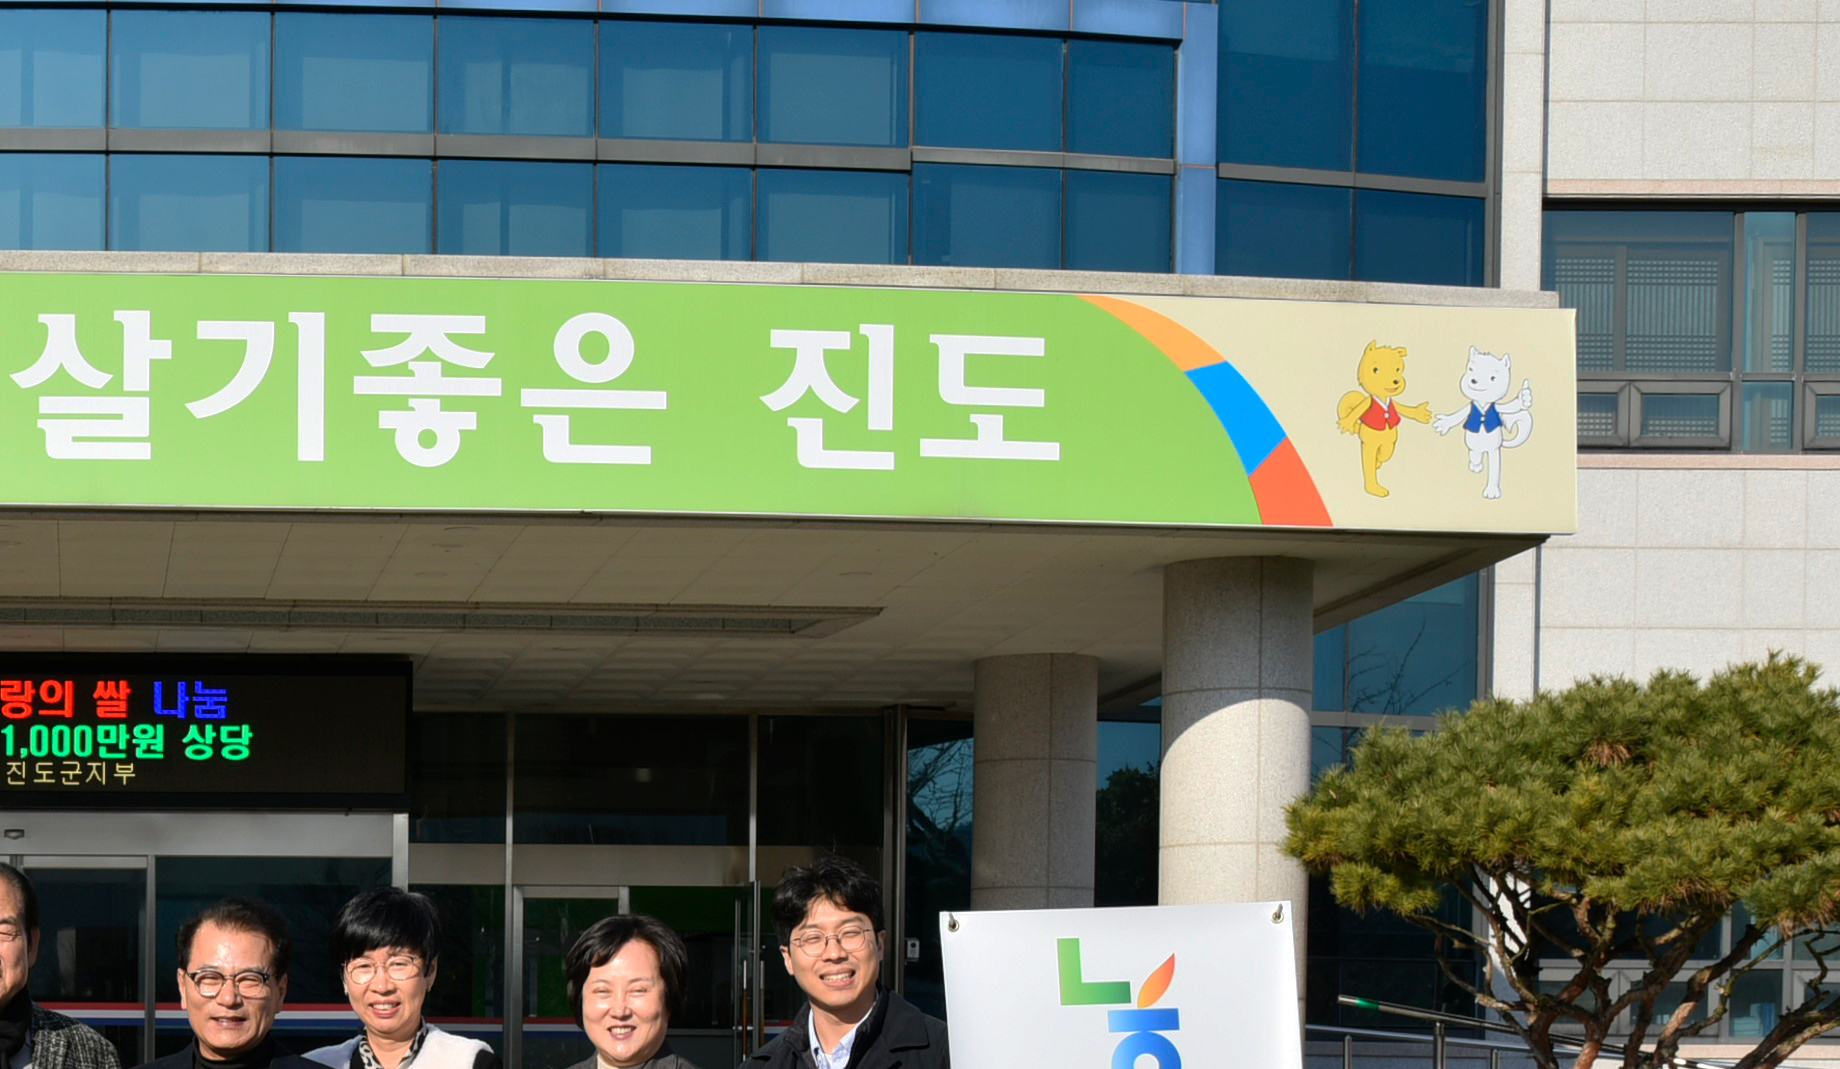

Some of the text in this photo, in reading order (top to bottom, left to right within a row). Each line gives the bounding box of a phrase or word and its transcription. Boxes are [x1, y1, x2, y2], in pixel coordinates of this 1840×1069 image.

[10, 310, 668, 467] 살기좋은
[760, 324, 1060, 470] 진도
[93, 680, 131, 718] 쌀
[154, 681, 228, 719] 나눔
[1, 724, 163, 758] 1,000만원
[183, 724, 253, 760] 상당
[7, 761, 135, 785] 진도군지부
